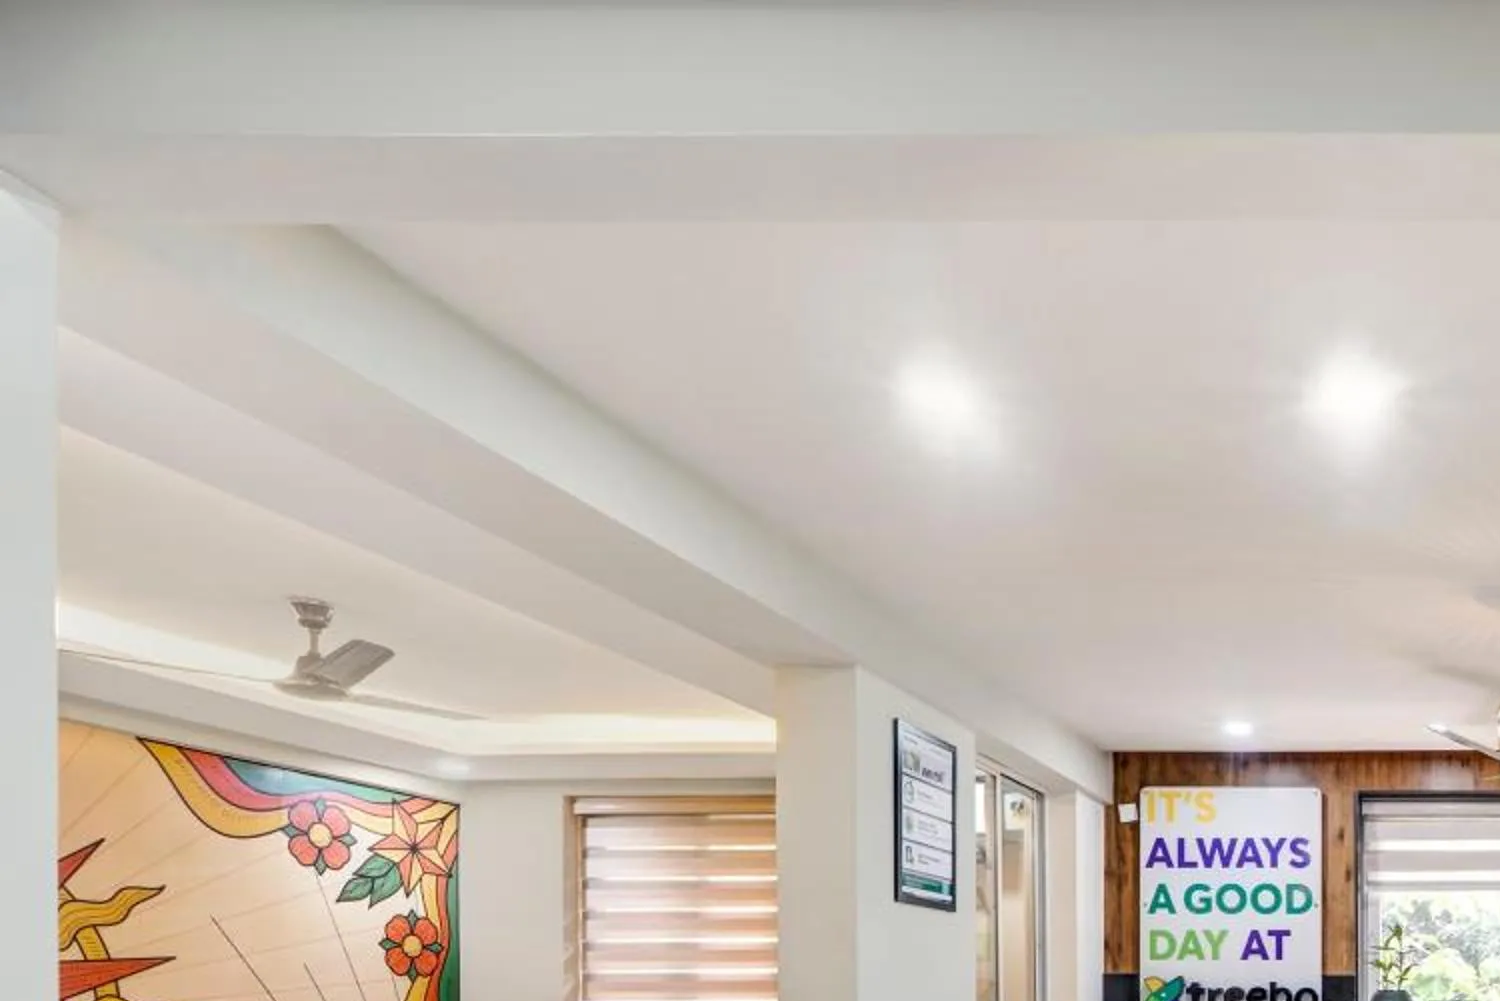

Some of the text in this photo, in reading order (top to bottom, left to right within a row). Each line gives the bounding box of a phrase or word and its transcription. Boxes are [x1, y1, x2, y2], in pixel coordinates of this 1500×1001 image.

[1145, 791, 1217, 824] IT'S
[1145, 837, 1312, 869] ALWAYS
[1147, 883, 1313, 915] A GOOD
[1149, 929, 1291, 961] DAY AT
